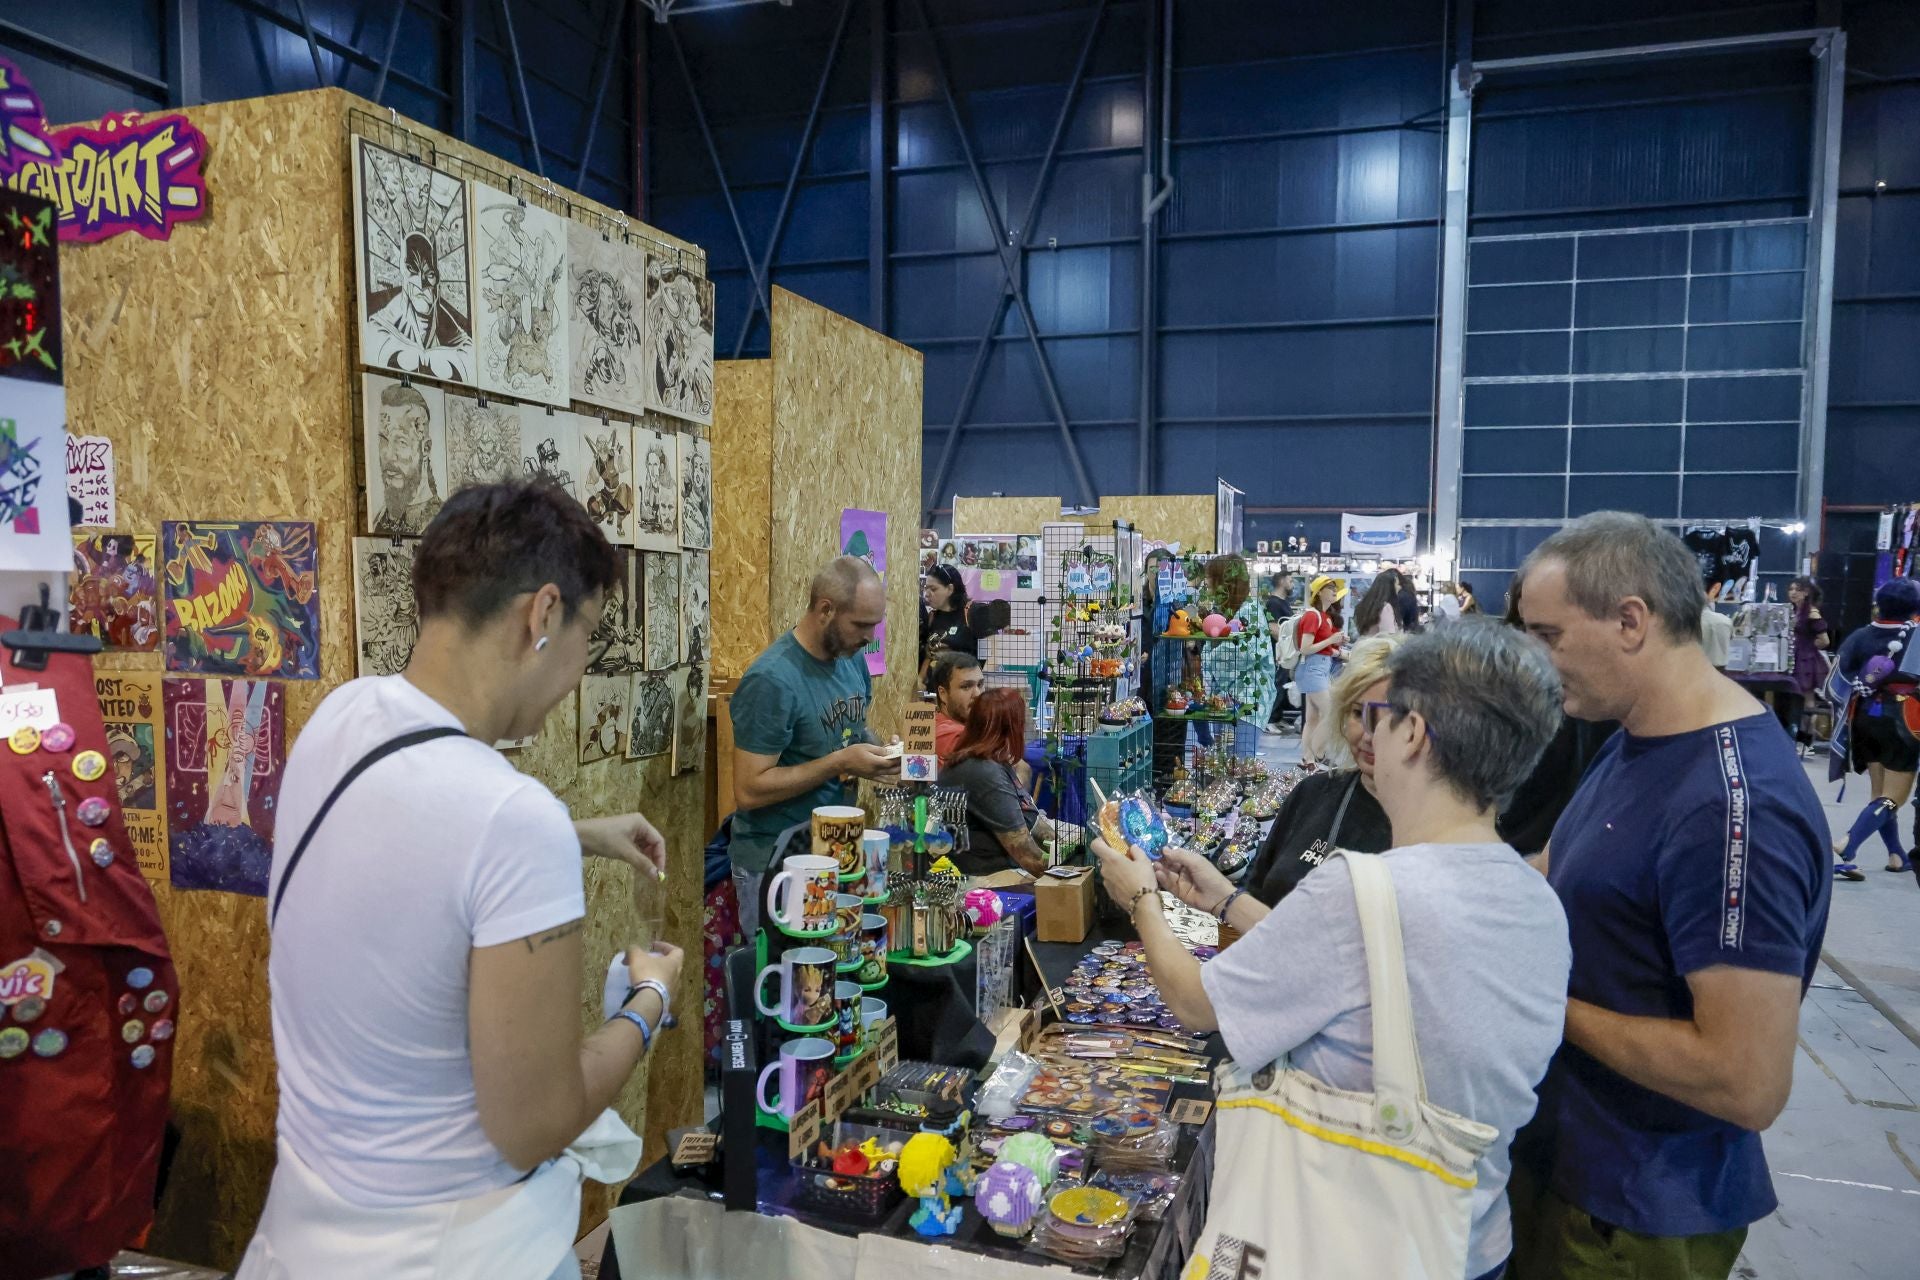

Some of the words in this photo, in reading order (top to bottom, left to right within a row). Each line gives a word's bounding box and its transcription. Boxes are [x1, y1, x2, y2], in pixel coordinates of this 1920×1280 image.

[96, 678, 123, 696] OST
[98, 699, 135, 717] NTED
[908, 741, 912, 750] 5
[914, 741, 933, 751] EUROS
[1732, 787, 1745, 825] TOMMY
[1728, 839, 1743, 888] HILFIGER
[1725, 907, 1740, 948] TOMMY
